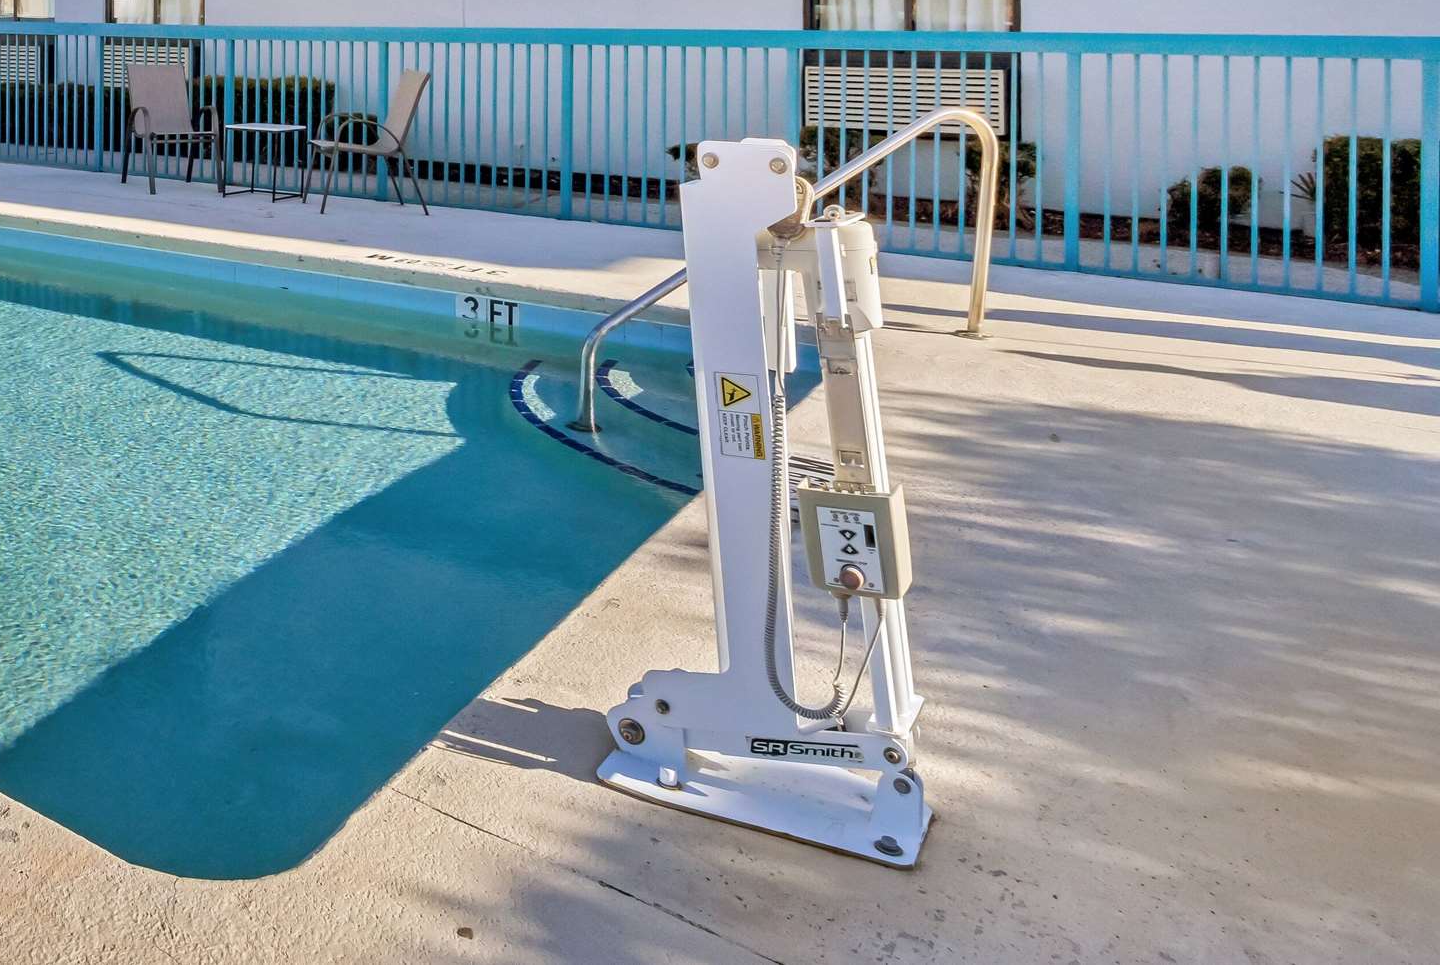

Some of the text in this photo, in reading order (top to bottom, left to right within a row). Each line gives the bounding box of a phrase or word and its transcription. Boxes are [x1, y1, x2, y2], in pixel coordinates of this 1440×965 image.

[462, 296, 518, 326] 3 FT
[753, 423, 763, 457] WARNING
